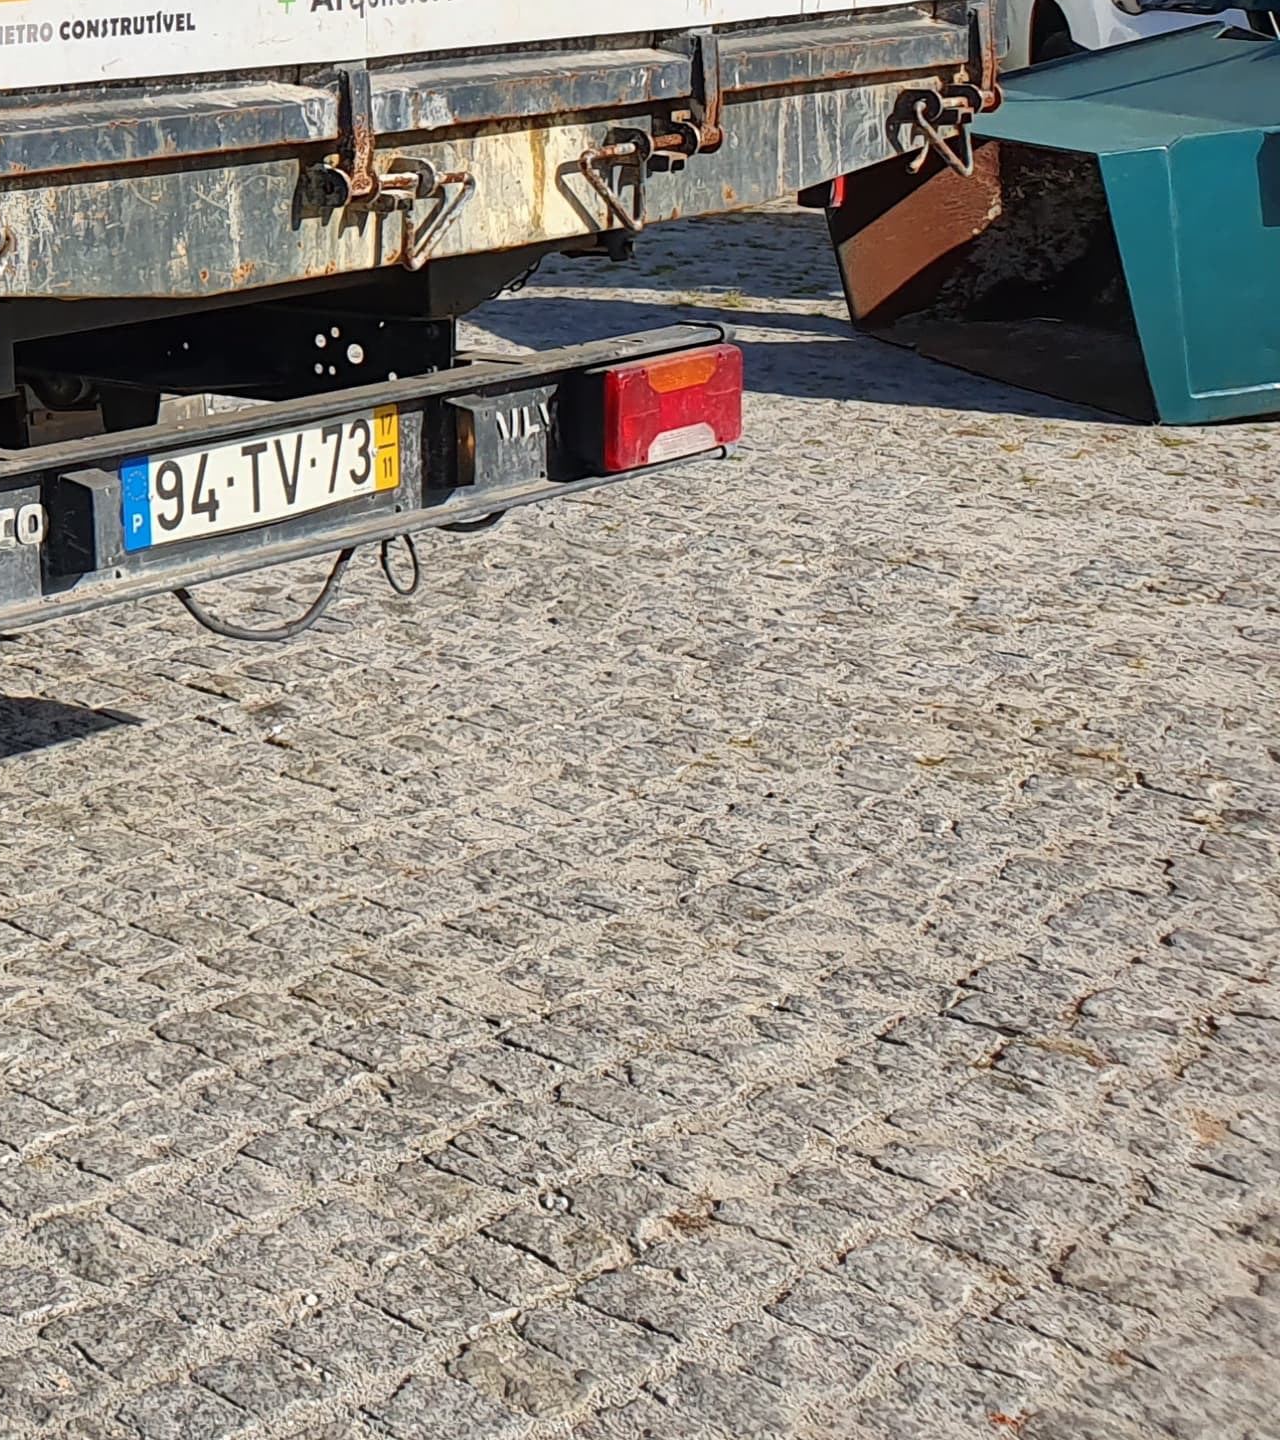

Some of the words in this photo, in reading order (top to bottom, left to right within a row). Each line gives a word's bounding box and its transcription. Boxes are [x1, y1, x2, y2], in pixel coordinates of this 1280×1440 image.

[59, 11, 196, 41] CONSTRUTÍVEL
[381, 412, 393, 436] 17
[383, 456, 393, 479] 11
[132, 513, 144, 534] P
